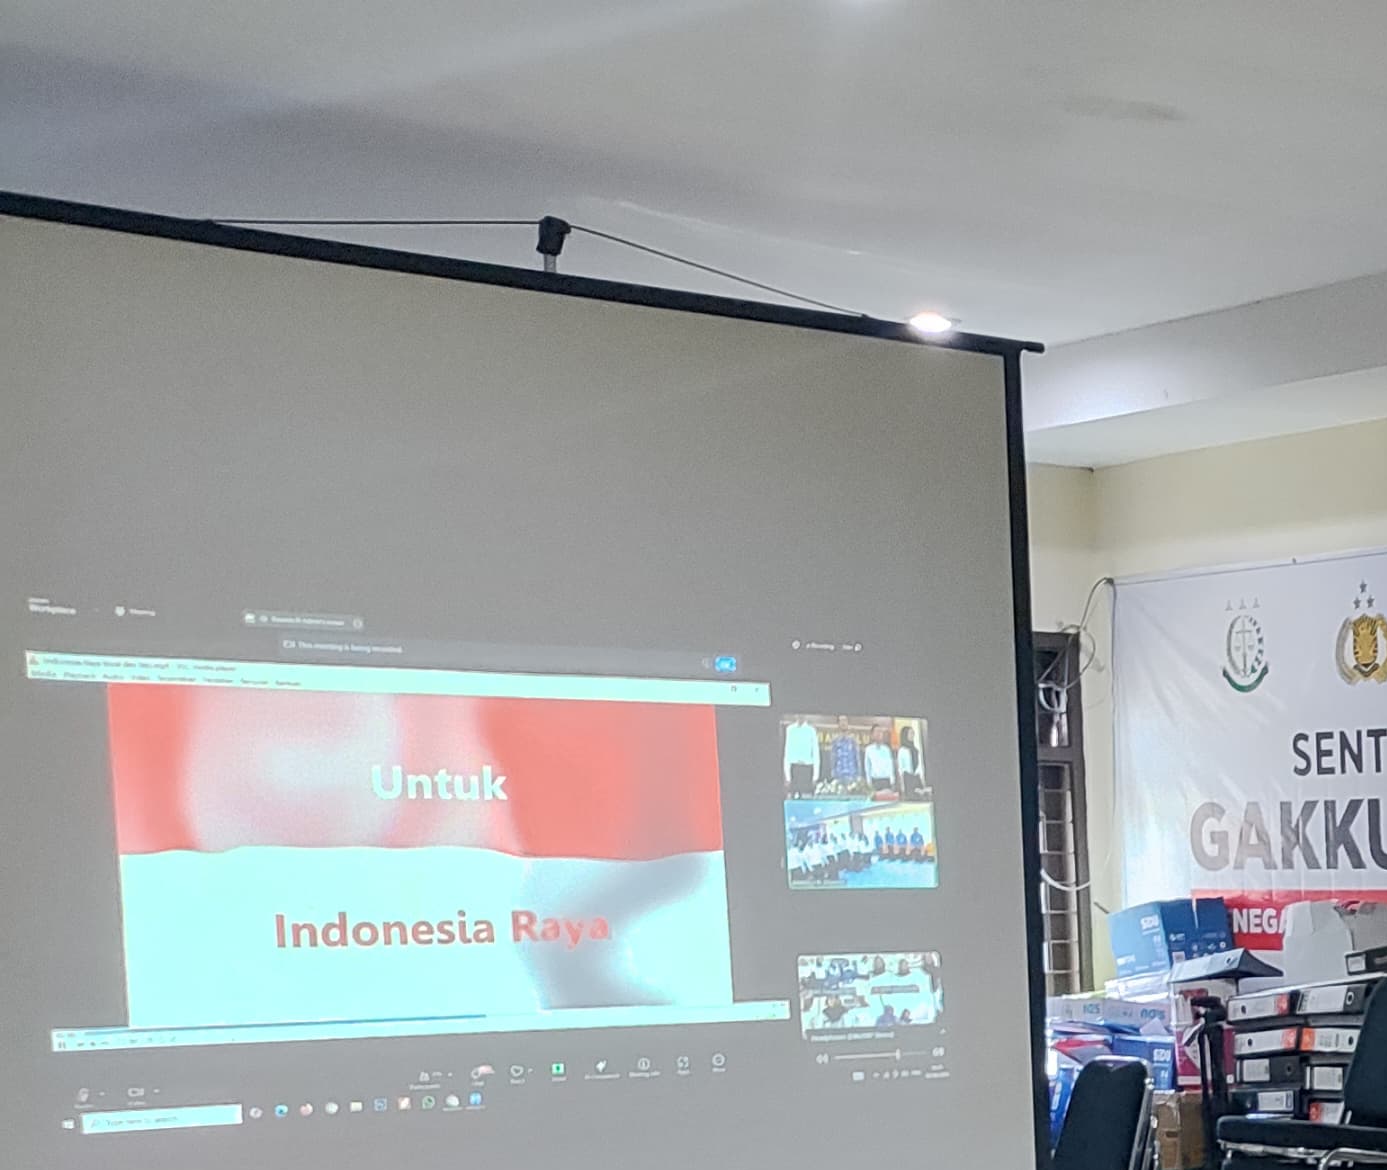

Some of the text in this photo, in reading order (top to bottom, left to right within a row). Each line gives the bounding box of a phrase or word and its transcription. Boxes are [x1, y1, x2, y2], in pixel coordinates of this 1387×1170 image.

[371, 764, 508, 800] Untuk
[275, 910, 611, 950] Indonesia Raya
